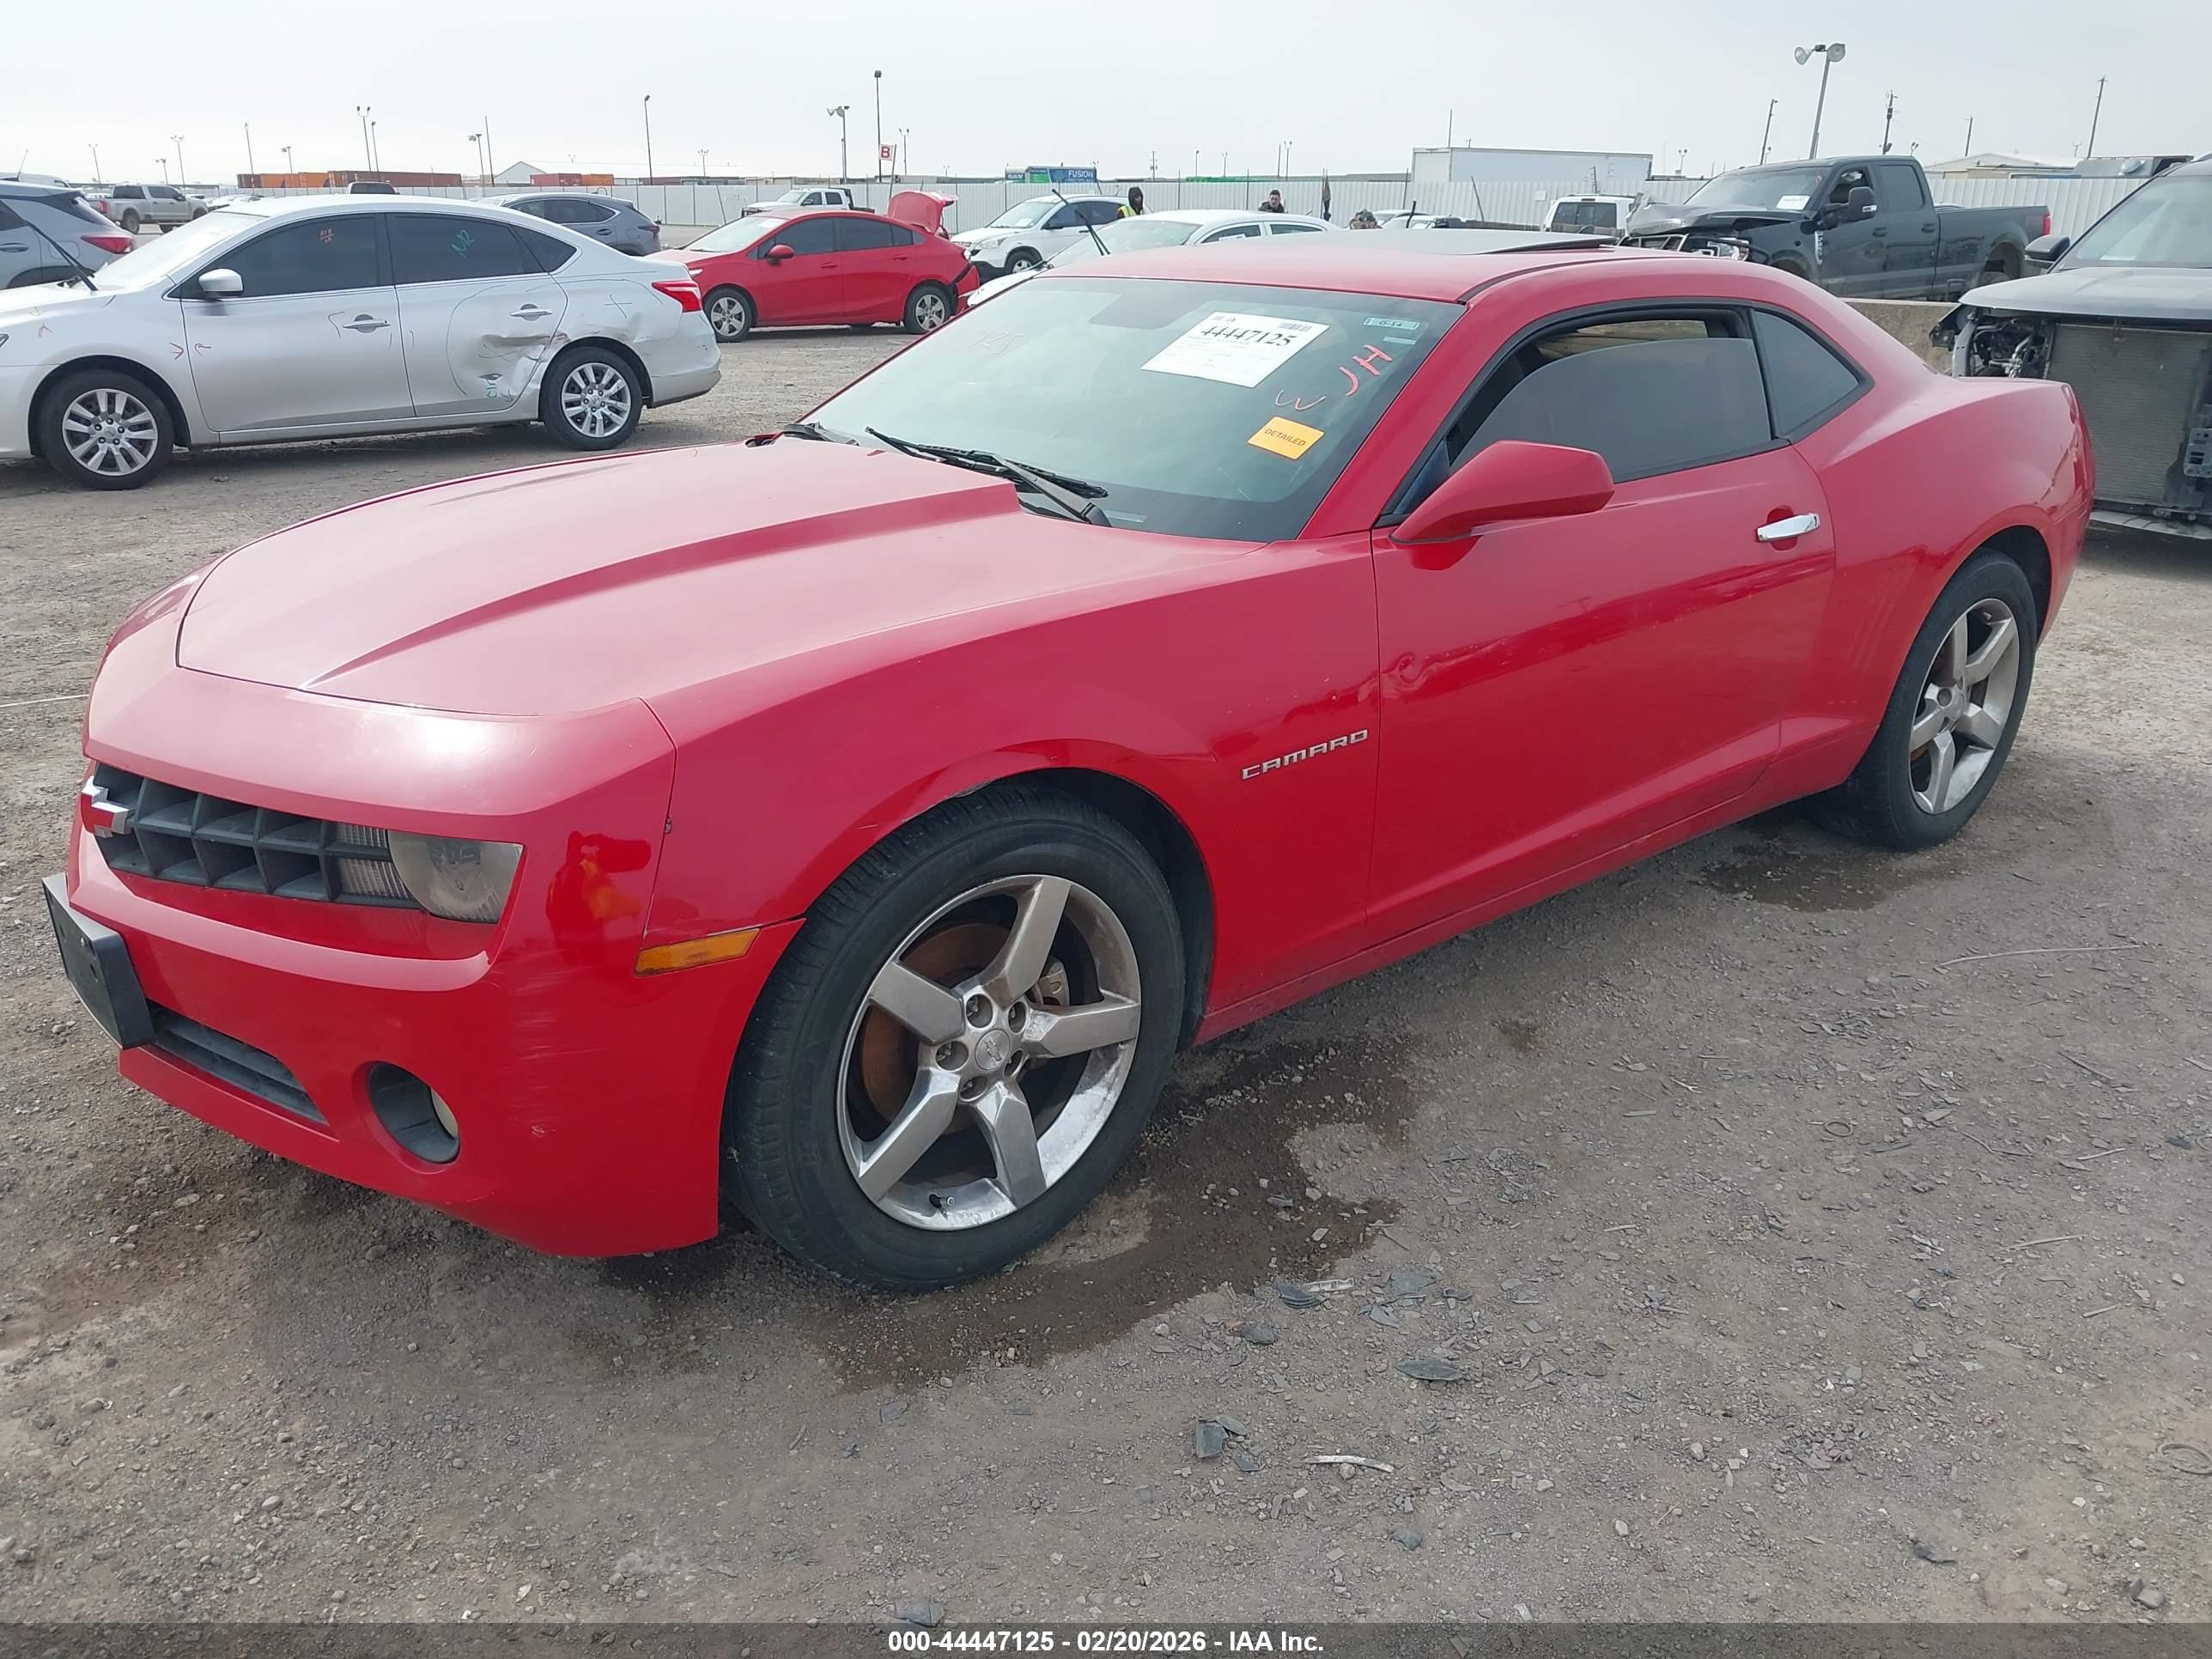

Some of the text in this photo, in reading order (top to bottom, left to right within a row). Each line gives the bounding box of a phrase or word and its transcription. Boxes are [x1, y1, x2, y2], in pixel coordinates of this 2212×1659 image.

[880, 146, 890, 159] B
[1067, 170, 1093, 179] FUSION
[1201, 325, 1297, 347] 44447125
[1264, 428, 1306, 447] DETAILED
[1242, 729, 1368, 780] CAMARO
